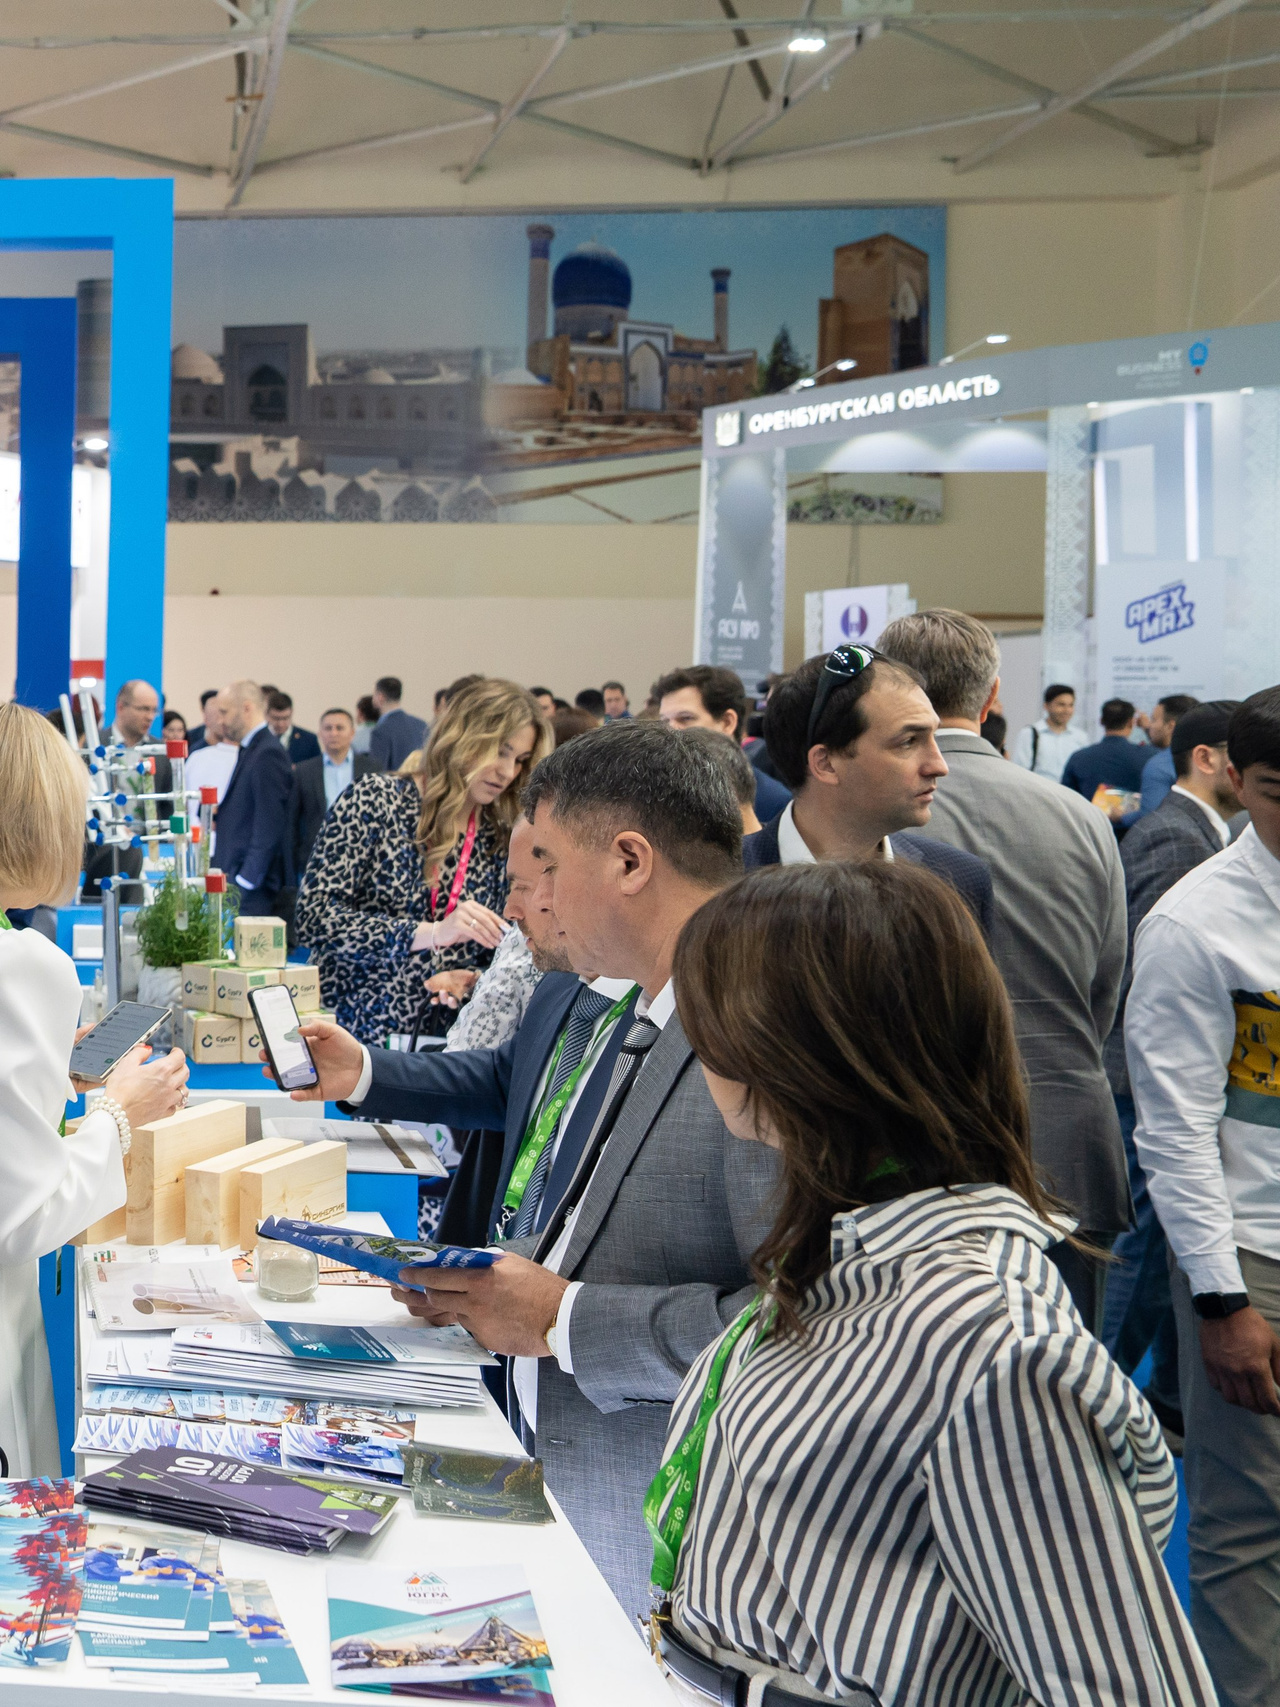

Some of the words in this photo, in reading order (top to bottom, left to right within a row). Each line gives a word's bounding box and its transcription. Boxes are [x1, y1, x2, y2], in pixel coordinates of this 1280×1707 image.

[748, 391, 895, 435] ОРЕНБУРГСКАЯ
[898, 374, 1001, 411] ОБЛАСТЬ
[1125, 585, 1185, 628] APEX
[1139, 602, 1194, 643] MAX
[167, 1457, 214, 1476] 10
